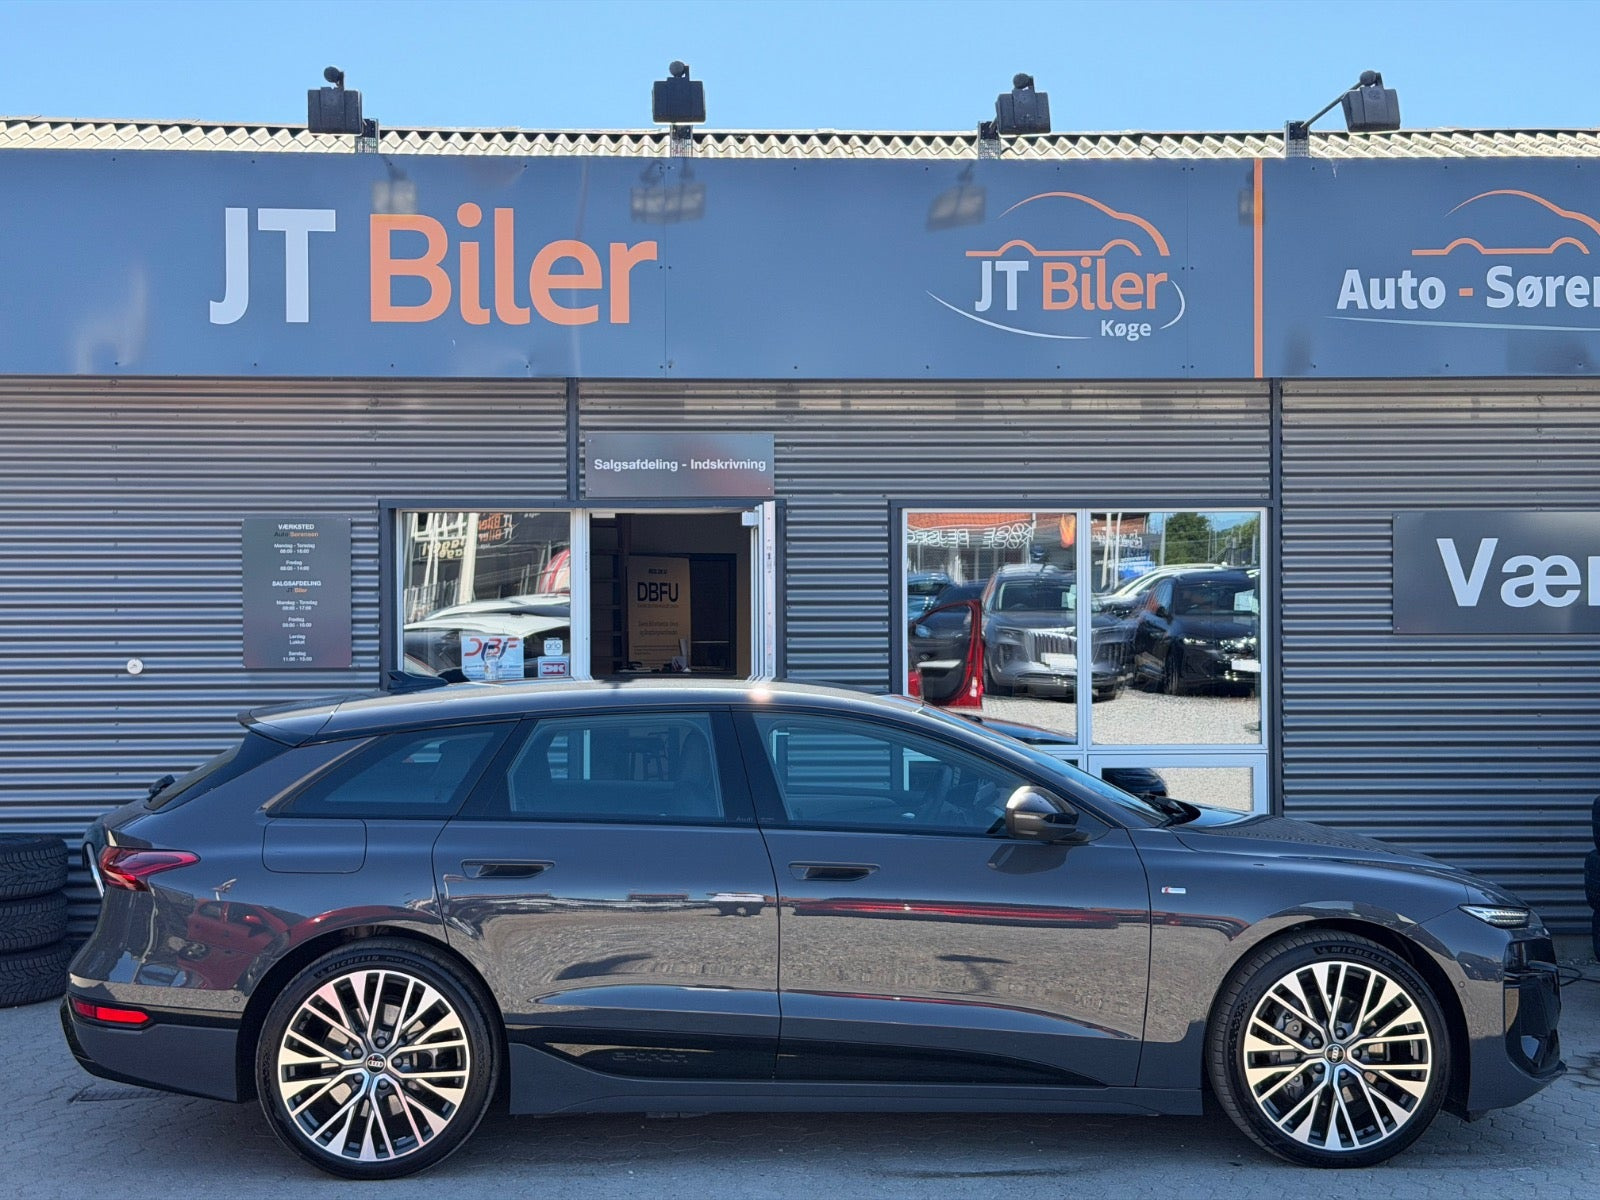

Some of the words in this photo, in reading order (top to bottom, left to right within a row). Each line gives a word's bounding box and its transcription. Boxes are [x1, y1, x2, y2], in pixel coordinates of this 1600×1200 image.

[209, 207, 336, 325] JT
[369, 202, 658, 326] Biler
[974, 260, 1029, 312] JT
[1042, 256, 1168, 311] Biler
[1336, 268, 1447, 310] Auto
[1458, 287, 1474, 297] -
[1486, 265, 1600, 309] Søre
[1100, 319, 1152, 342] Køge
[593, 458, 679, 473] Salgsafdeling
[690, 458, 767, 472] Indskrivning
[277, 523, 316, 531] VÆRKSTED
[637, 582, 679, 602] DBFU
[326, 954, 381, 973] MICHELIN
[1330, 946, 1392, 968] MICHELIN
